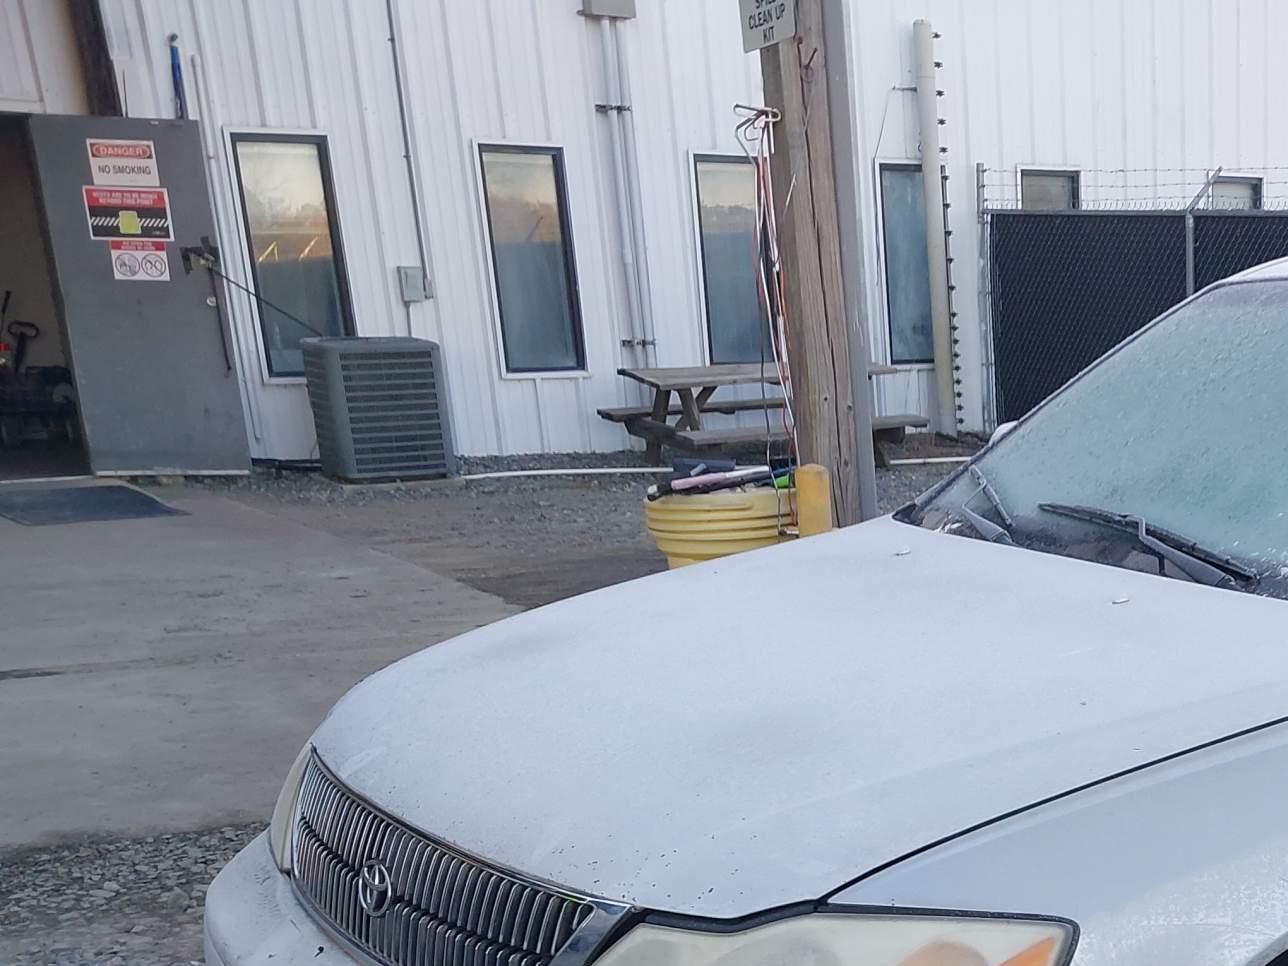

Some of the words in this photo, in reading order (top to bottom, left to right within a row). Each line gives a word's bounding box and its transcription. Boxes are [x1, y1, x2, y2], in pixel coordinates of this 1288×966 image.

[748, 9, 774, 30] CLEAN
[775, 3, 786, 20] UP
[762, 26, 775, 44] KIT
[100, 146, 144, 156] DANGER
[98, 165, 111, 174] NO
[112, 165, 152, 175] SMOKING
